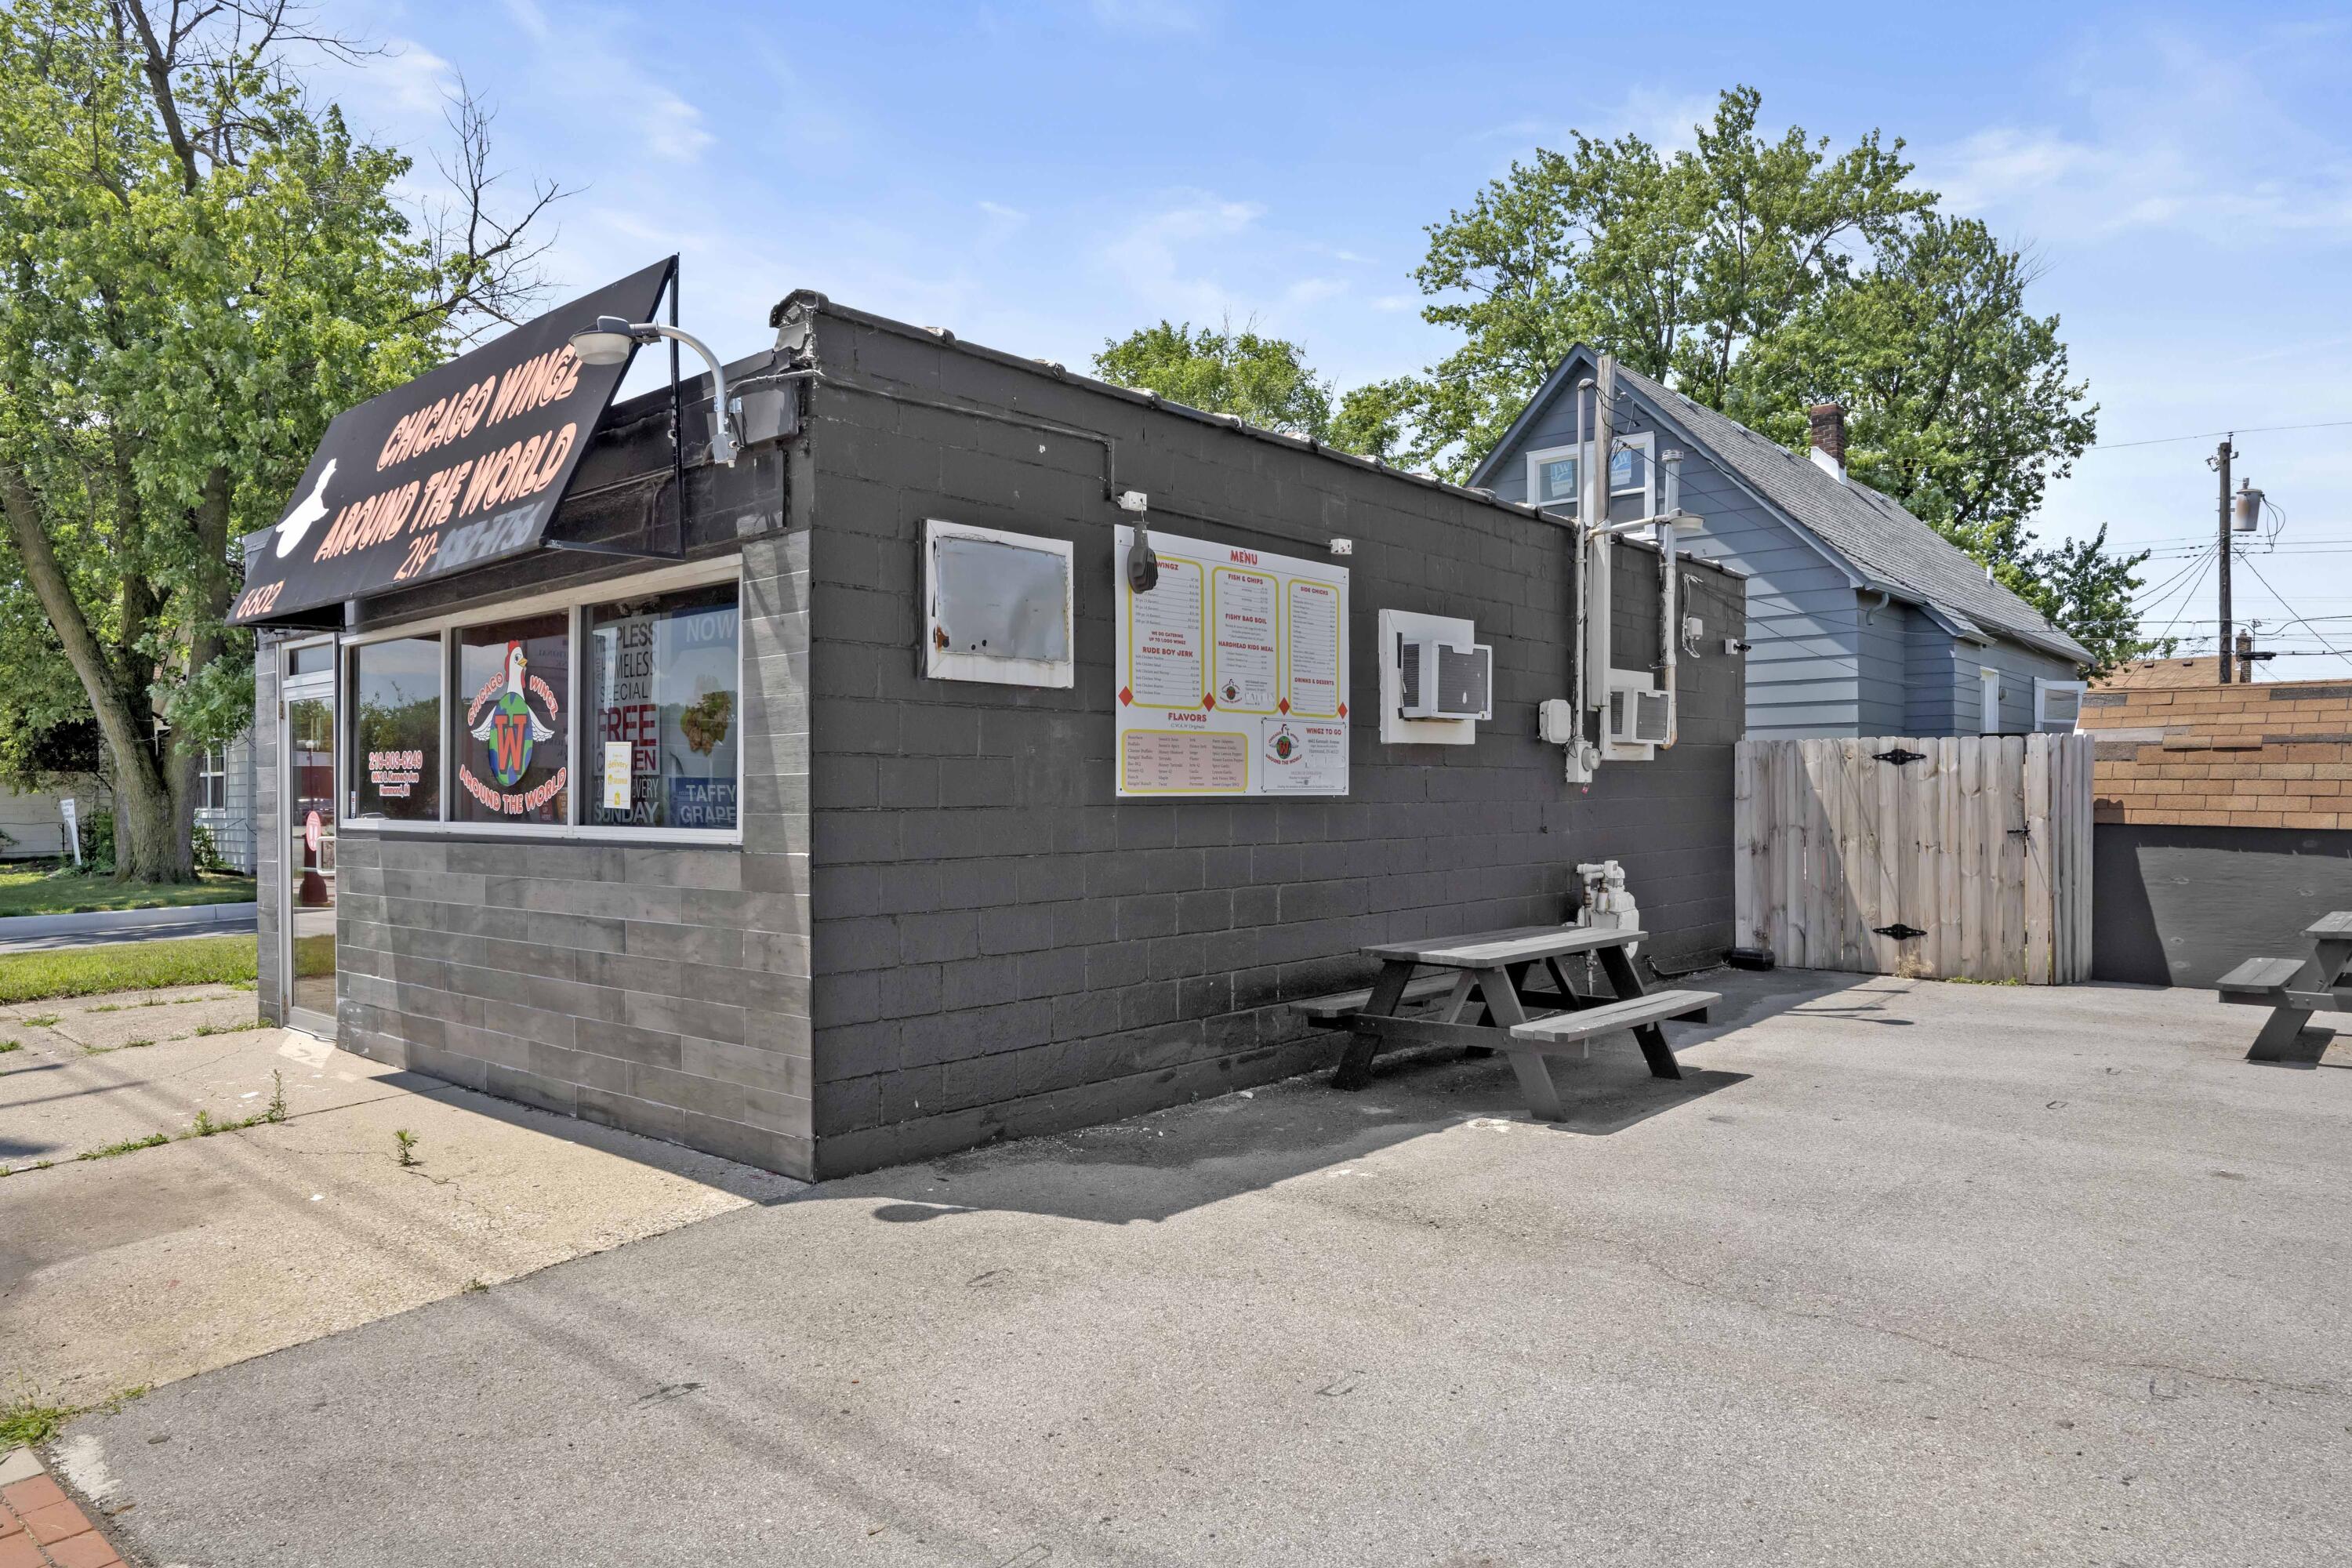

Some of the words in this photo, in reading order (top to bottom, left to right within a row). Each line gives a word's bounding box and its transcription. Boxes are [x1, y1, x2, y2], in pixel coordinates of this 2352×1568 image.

[376, 375, 495, 472] CHICAGO
[314, 480, 420, 563] AROUND
[408, 460, 473, 534] THE
[459, 422, 577, 519] WORLD
[1230, 550, 1258, 564] MENU
[236, 580, 284, 619] 6602
[686, 614, 735, 642] NOW
[1218, 641, 1247, 649] HARDHEAD
[467, 672, 503, 726] CHICAGO
[530, 675, 558, 720] WINGZ
[600, 681, 649, 703] SPECIAL
[598, 704, 656, 749] FREE
[1168, 712, 1207, 722] FLAVORS
[495, 714, 527, 775] W
[459, 764, 502, 811] AROUND
[503, 794, 523, 814] THE
[524, 767, 566, 811] WORLD
[686, 785, 736, 802] TAFFY
[594, 800, 659, 824] SUNDAY
[681, 805, 736, 824] GRAPE
